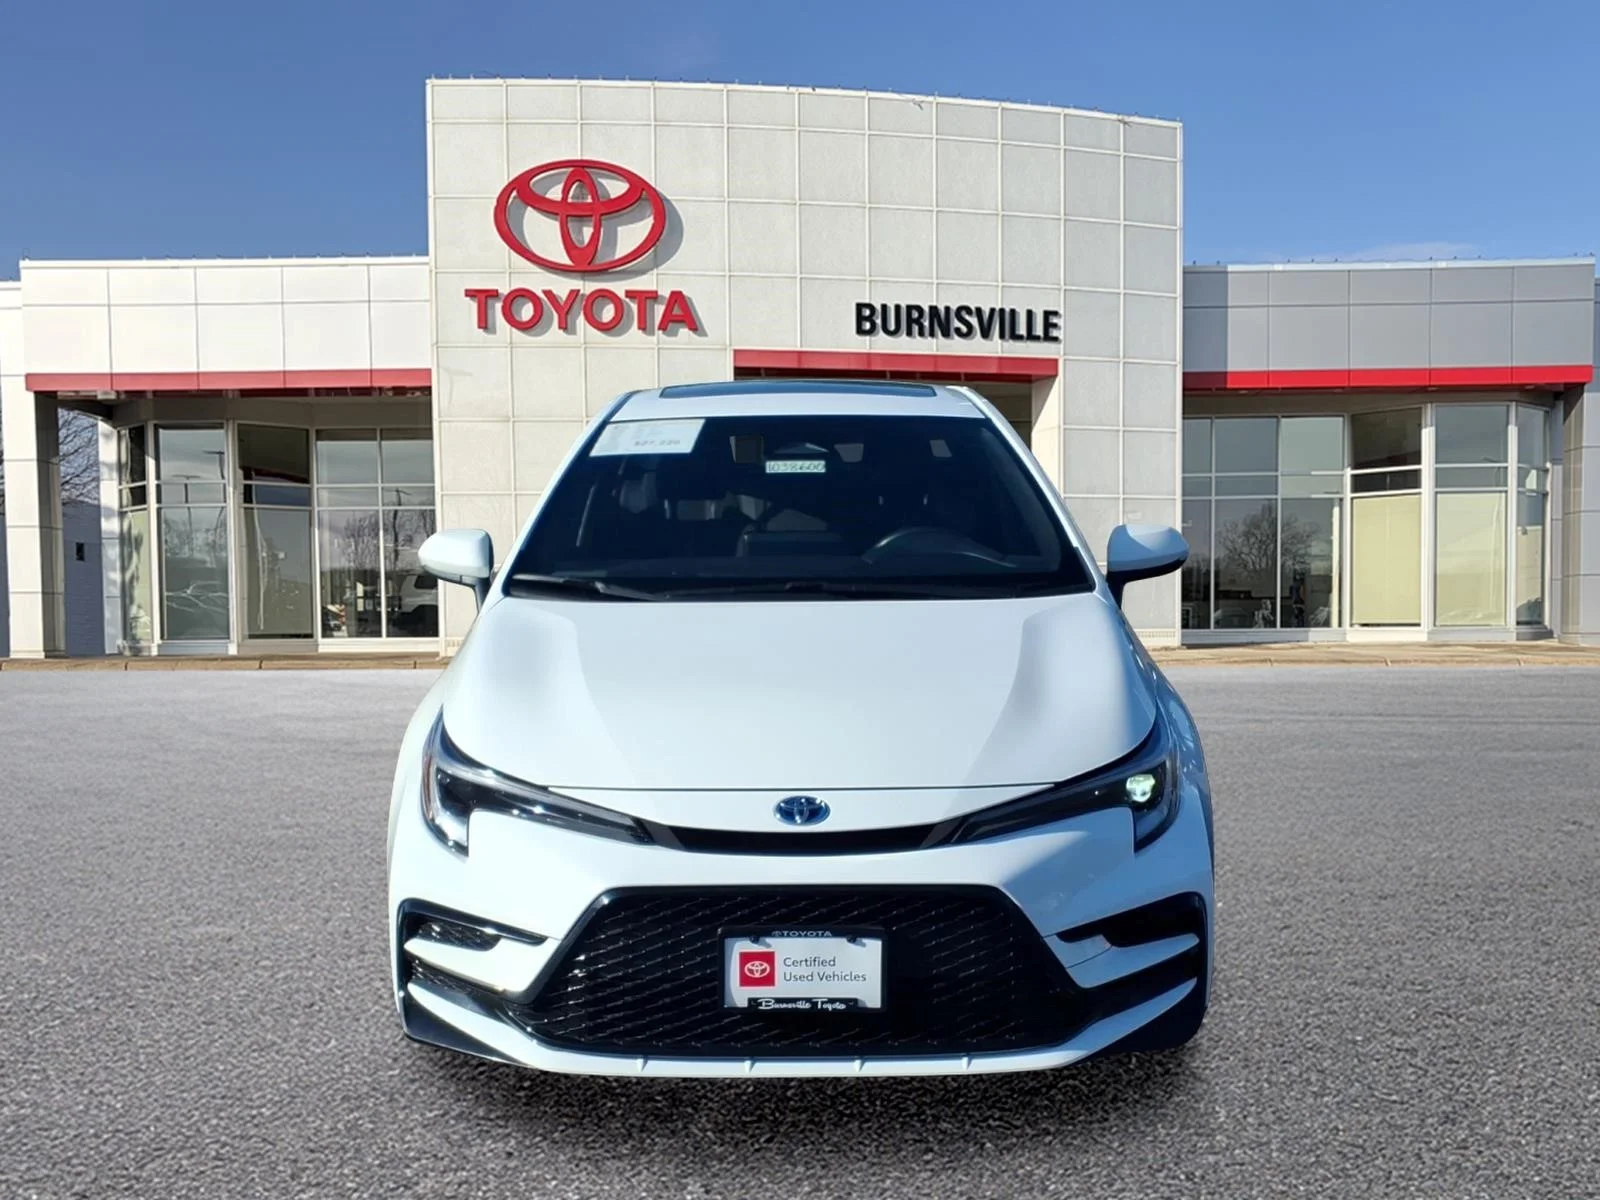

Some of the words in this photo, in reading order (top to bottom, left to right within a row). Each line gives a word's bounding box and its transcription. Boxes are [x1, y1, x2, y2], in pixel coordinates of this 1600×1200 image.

[464, 288, 699, 331] TOYOTA
[855, 302, 1062, 342] BURNSVILLE
[783, 957, 836, 967] Certified
[783, 971, 814, 982] Used
[817, 971, 867, 982] Vehicles
[757, 998, 811, 1010] Burnsville
[812, 998, 846, 1011] Toyota
